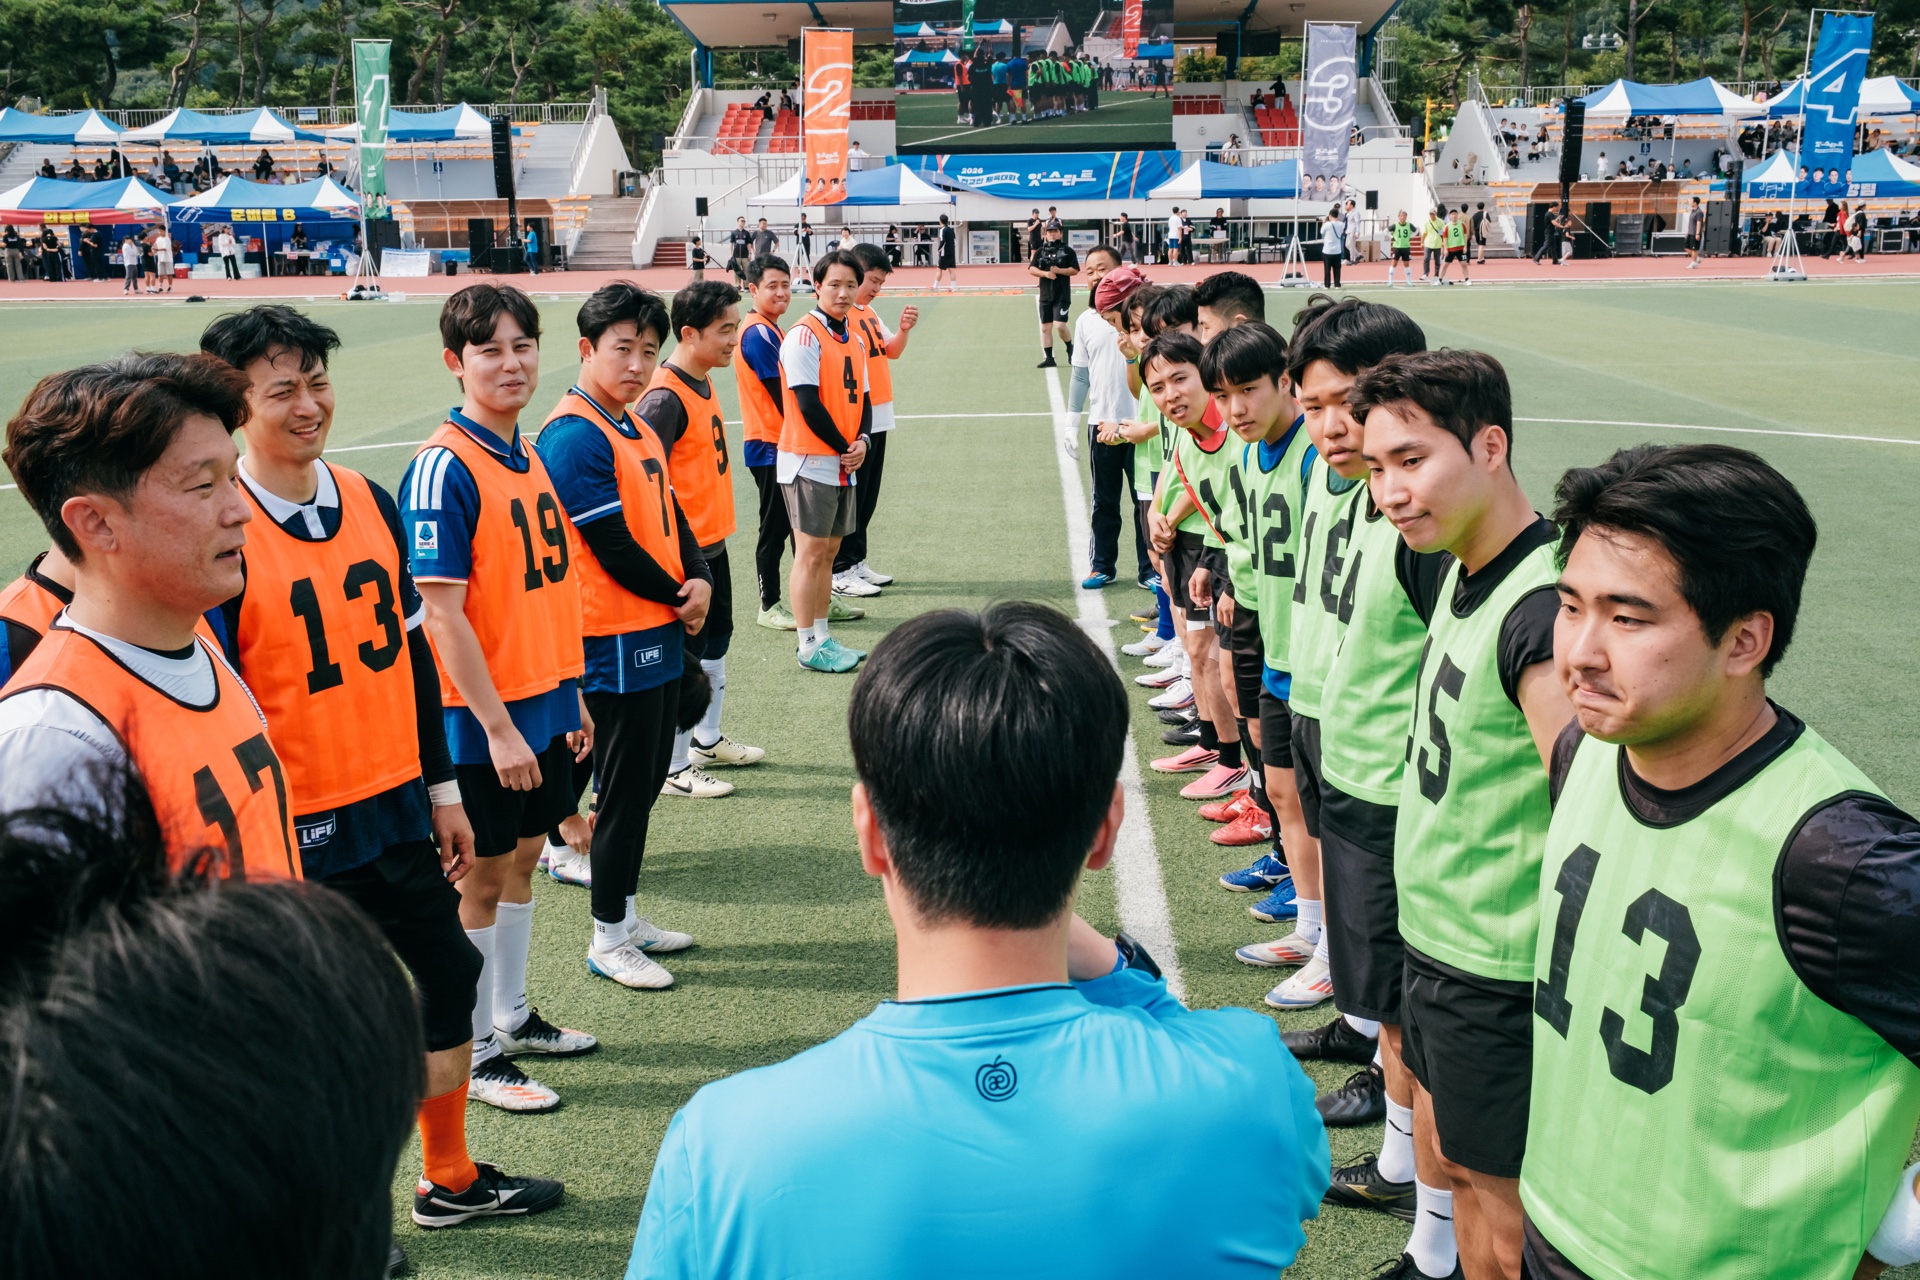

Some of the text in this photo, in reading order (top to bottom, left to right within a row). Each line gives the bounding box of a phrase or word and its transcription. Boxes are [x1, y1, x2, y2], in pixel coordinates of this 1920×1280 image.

[804, 62, 853, 135] 2
[1805, 48, 1871, 124] 4
[43, 211, 90, 224] 의료팀
[230, 208, 296, 222] 준비팀 B
[1398, 229, 1409, 238] 19
[1453, 228, 1459, 238] 2
[843, 355, 858, 404] 4
[711, 414, 729, 477] 9
[640, 457, 670, 537] 7
[1248, 488, 1296, 578] 12
[510, 491, 570, 593] 19
[289, 558, 404, 695] 13
[193, 732, 304, 882] 17
[1534, 843, 1703, 1096] 13
